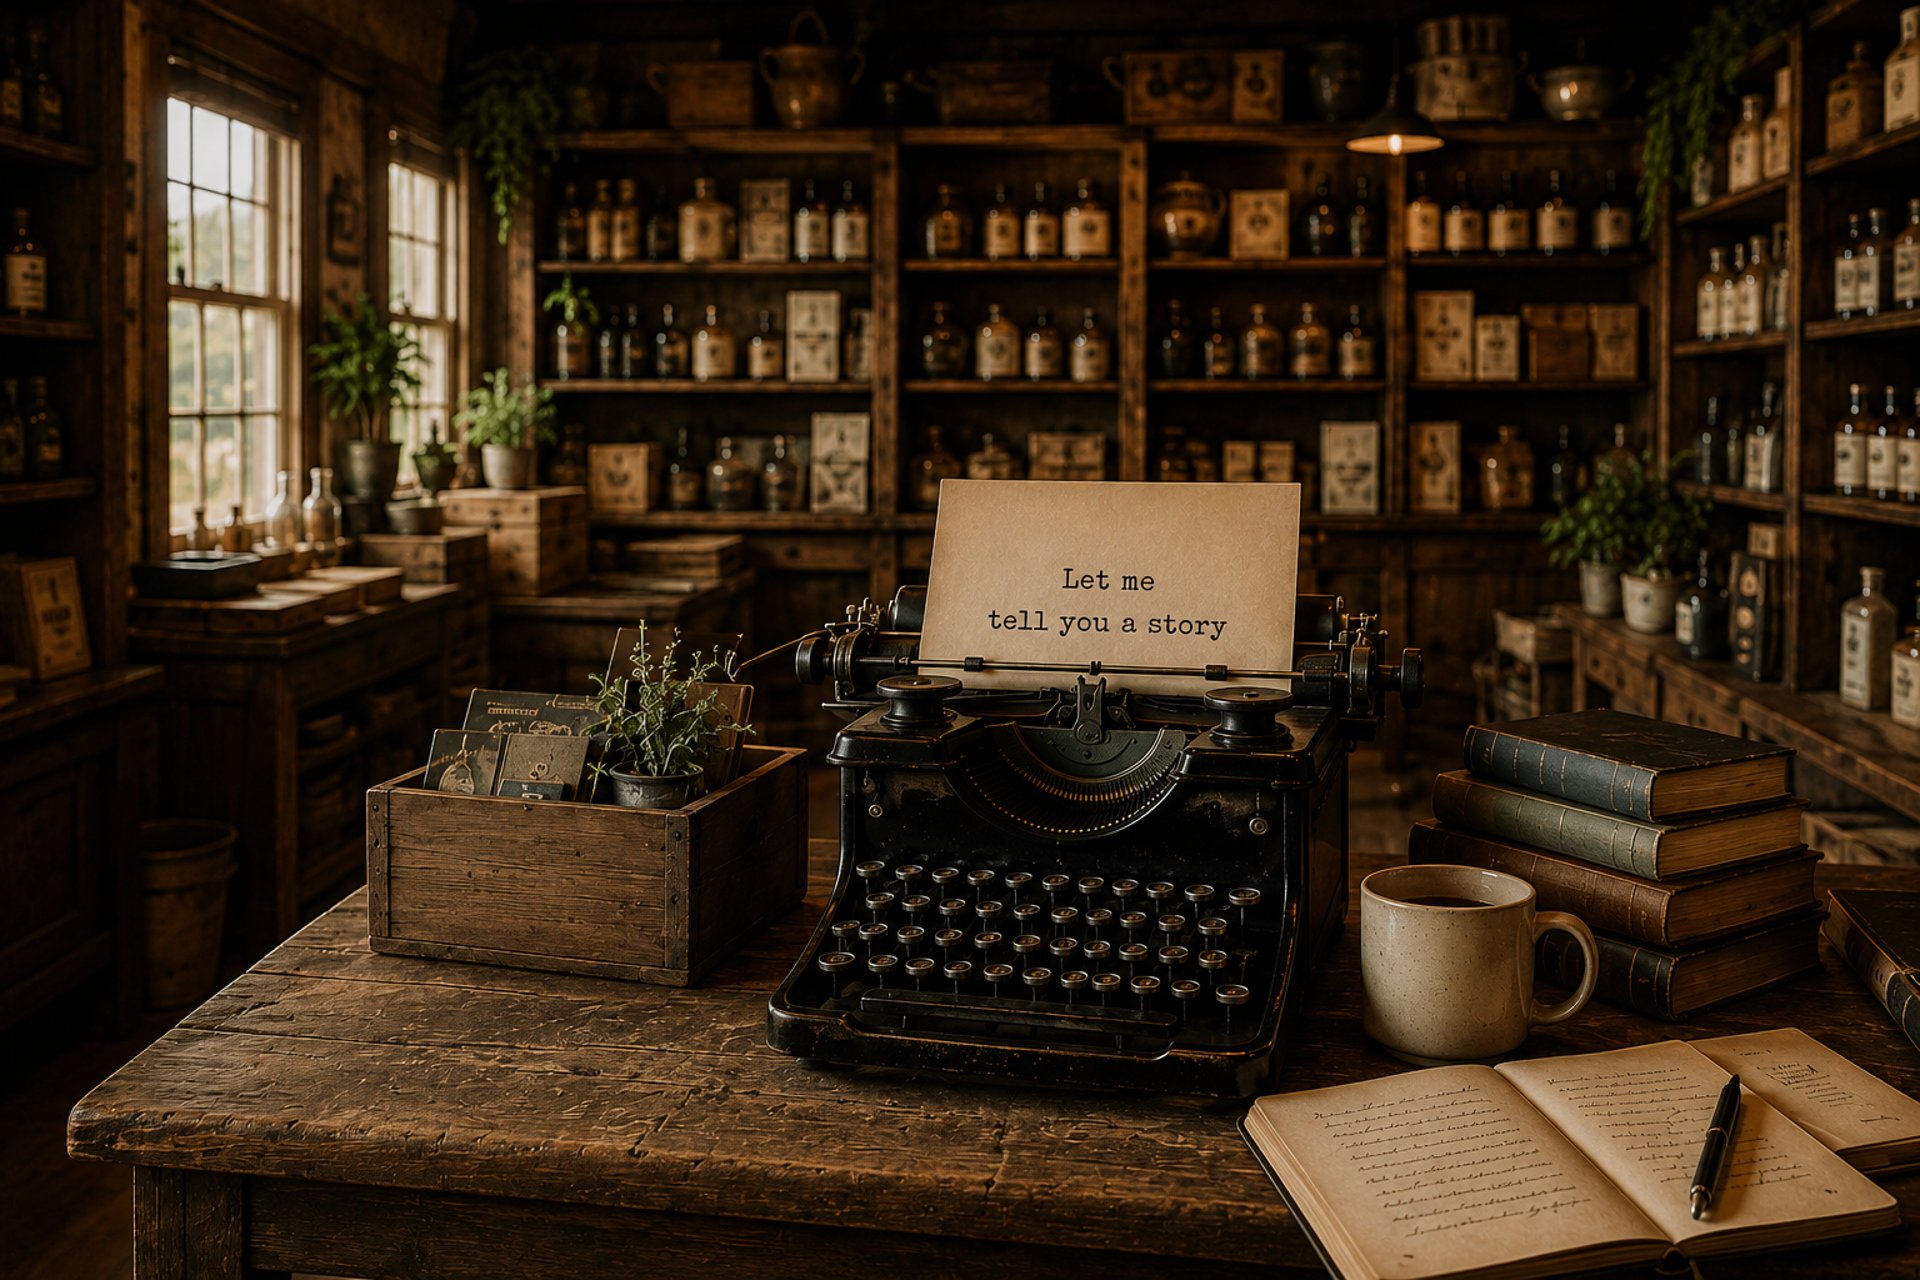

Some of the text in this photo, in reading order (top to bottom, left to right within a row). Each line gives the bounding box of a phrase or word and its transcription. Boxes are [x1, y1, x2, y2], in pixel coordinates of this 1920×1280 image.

[1062, 568, 1155, 591] Let me
[988, 609, 1228, 641] tell you a story
